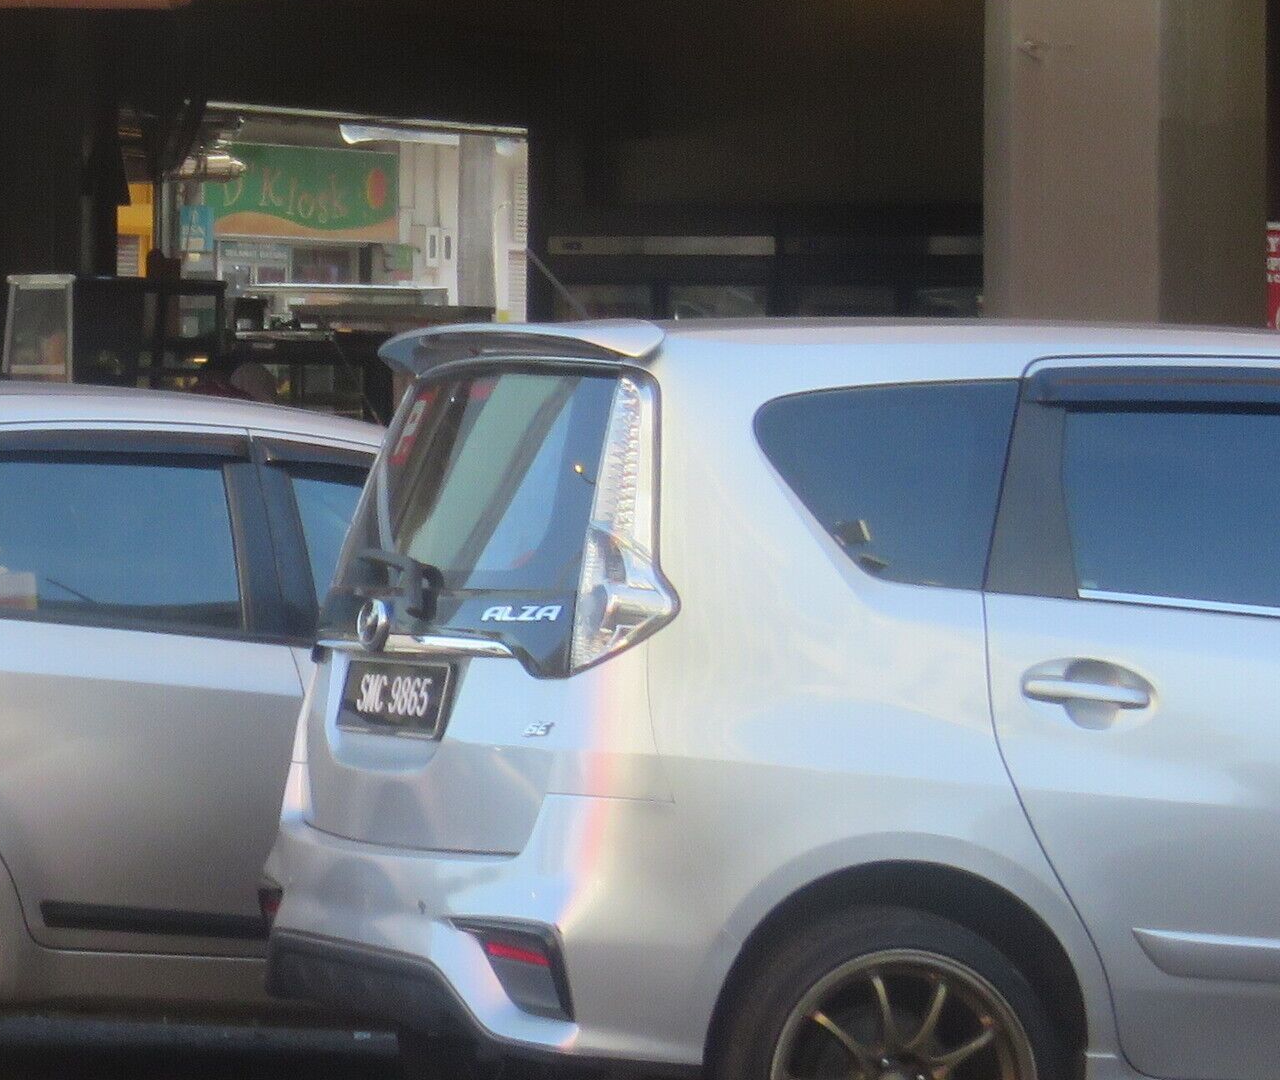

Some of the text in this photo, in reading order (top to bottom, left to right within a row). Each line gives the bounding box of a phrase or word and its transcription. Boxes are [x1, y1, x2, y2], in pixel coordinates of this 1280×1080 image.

[481, 604, 562, 622] ALZA
[356, 673, 433, 717] SMC 9865
